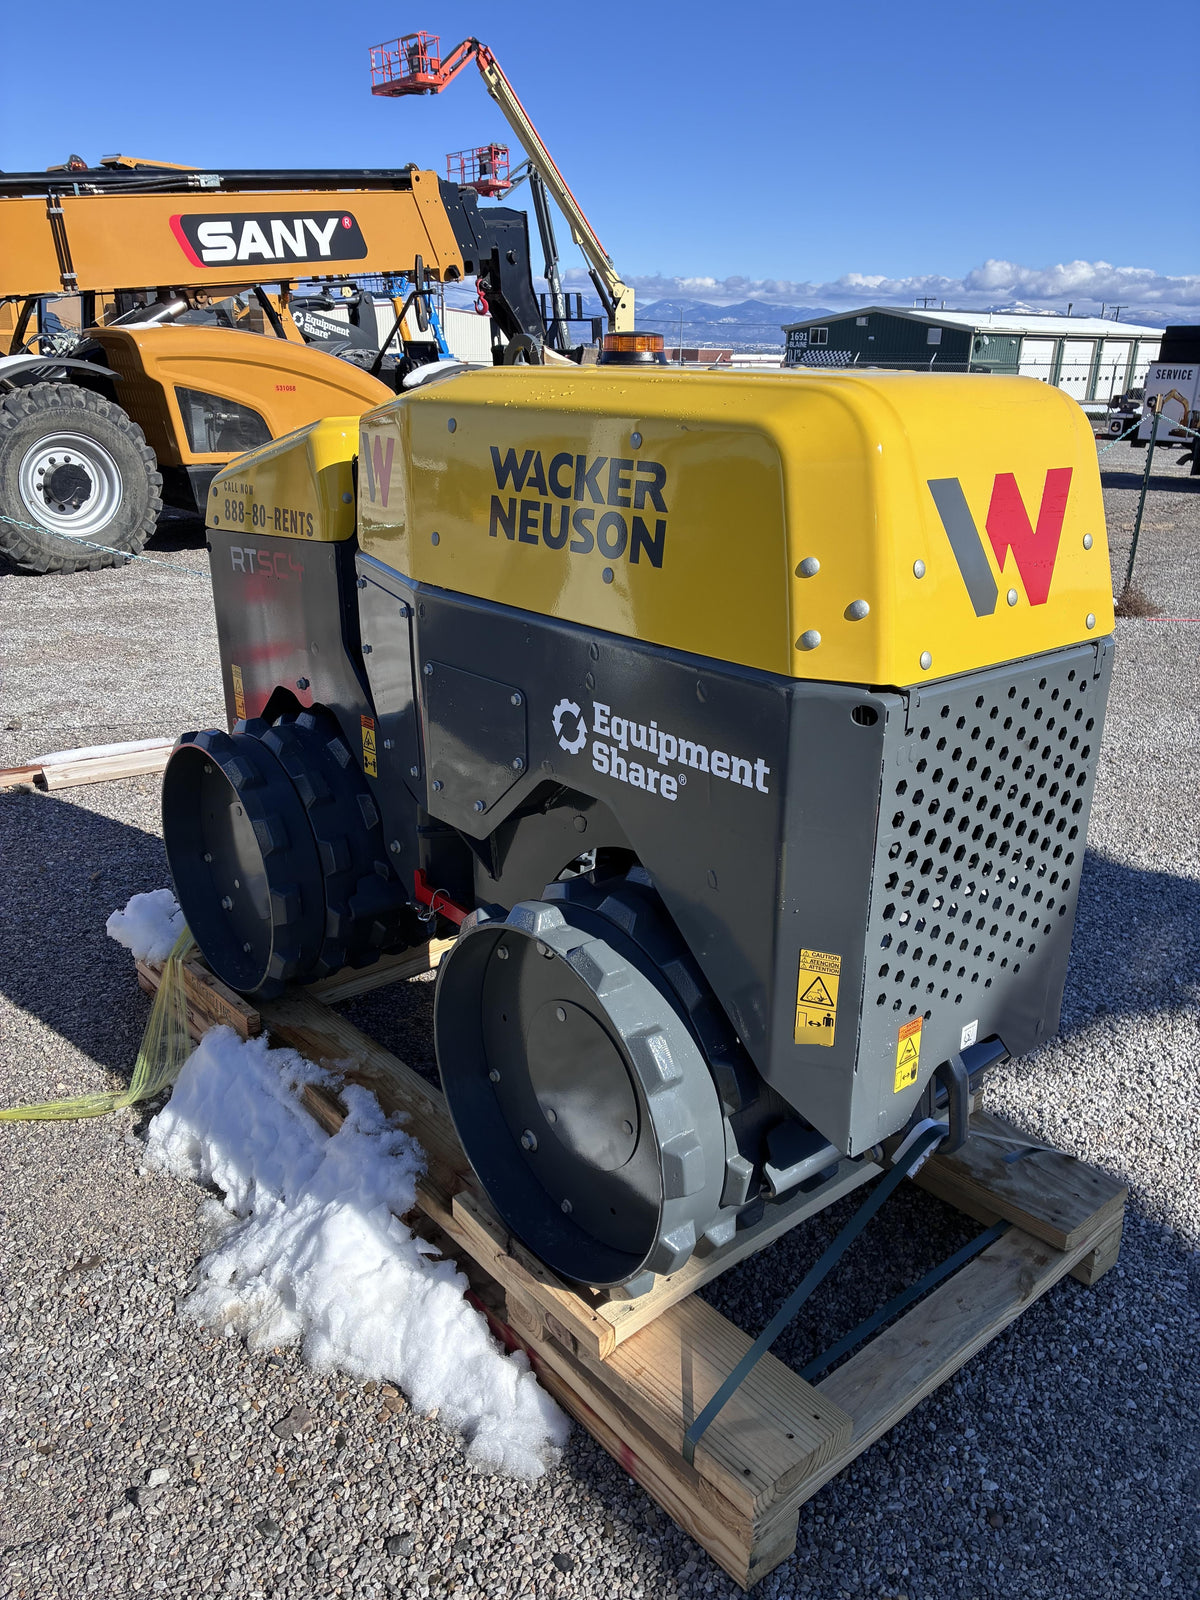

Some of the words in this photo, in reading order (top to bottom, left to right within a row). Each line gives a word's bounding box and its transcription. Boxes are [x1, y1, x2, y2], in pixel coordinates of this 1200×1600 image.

[305, 313, 350, 337] Equipment
[790, 332, 808, 341] 1691
[1155, 368, 1193, 381] SERVICE
[223, 480, 238, 494] CALL
[240, 483, 254, 496] NOW
[489, 446, 669, 514] WACKER
[224, 498, 315, 538] 888-80-RENTS
[489, 494, 667, 569] NEUSON
[592, 701, 770, 794] Equipment
[811, 951, 840, 961] CAUTION
[808, 965, 840, 975] ATTENTION
